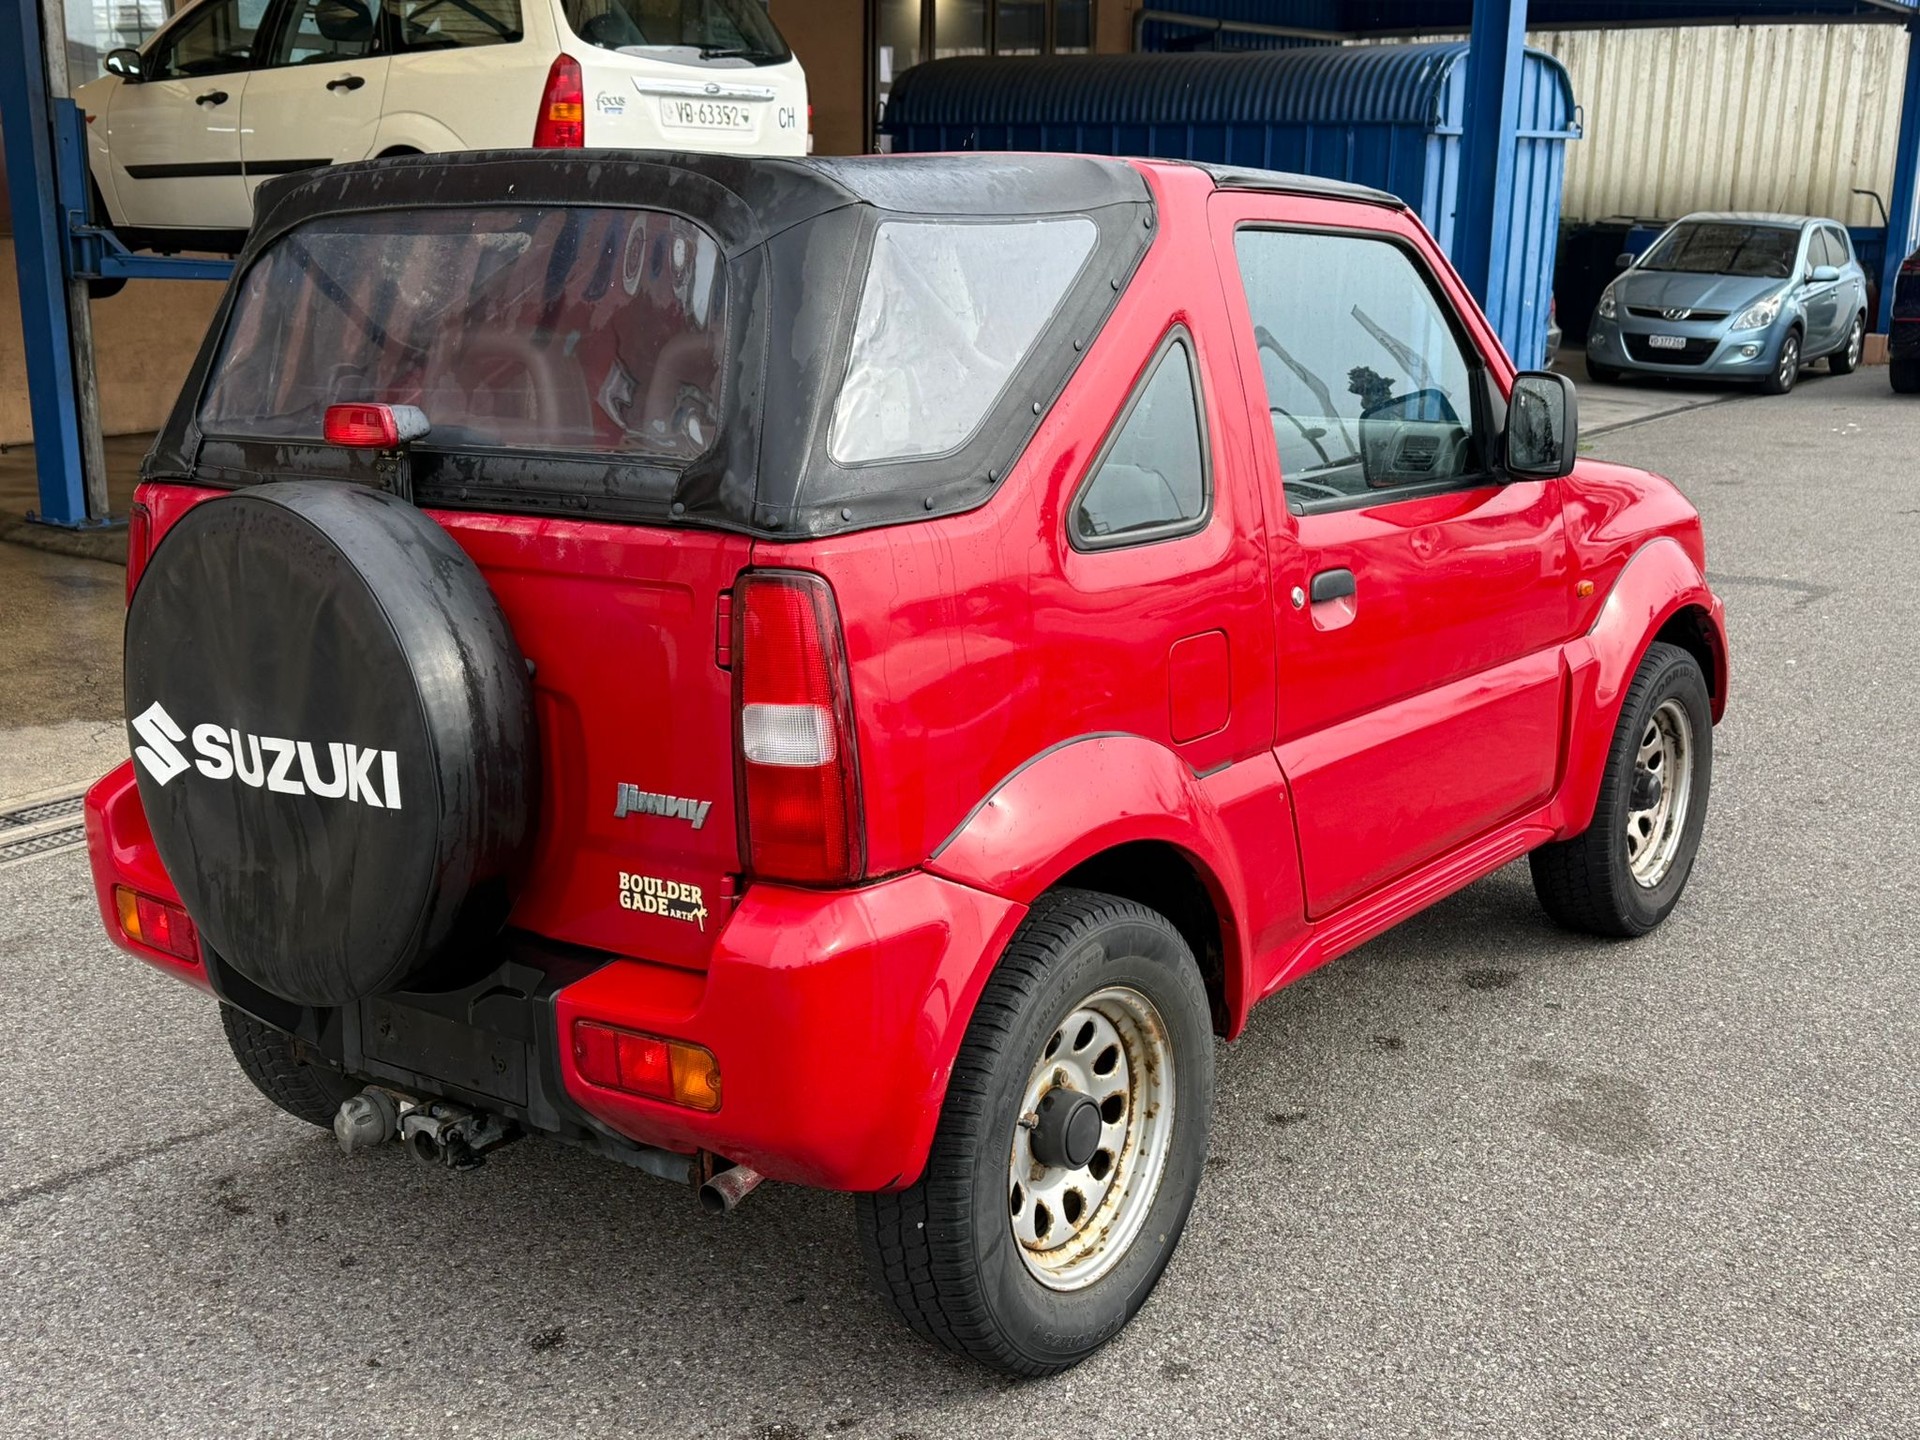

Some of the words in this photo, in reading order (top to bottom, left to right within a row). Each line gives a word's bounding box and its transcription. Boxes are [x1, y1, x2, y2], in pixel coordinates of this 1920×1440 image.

[778, 107, 796, 129] CH
[191, 723, 402, 810] SUZUKI
[613, 782, 713, 830] Jimny
[618, 871, 702, 905] BOULDER
[619, 890, 669, 916] GADE
[669, 908, 694, 922] ARTH
